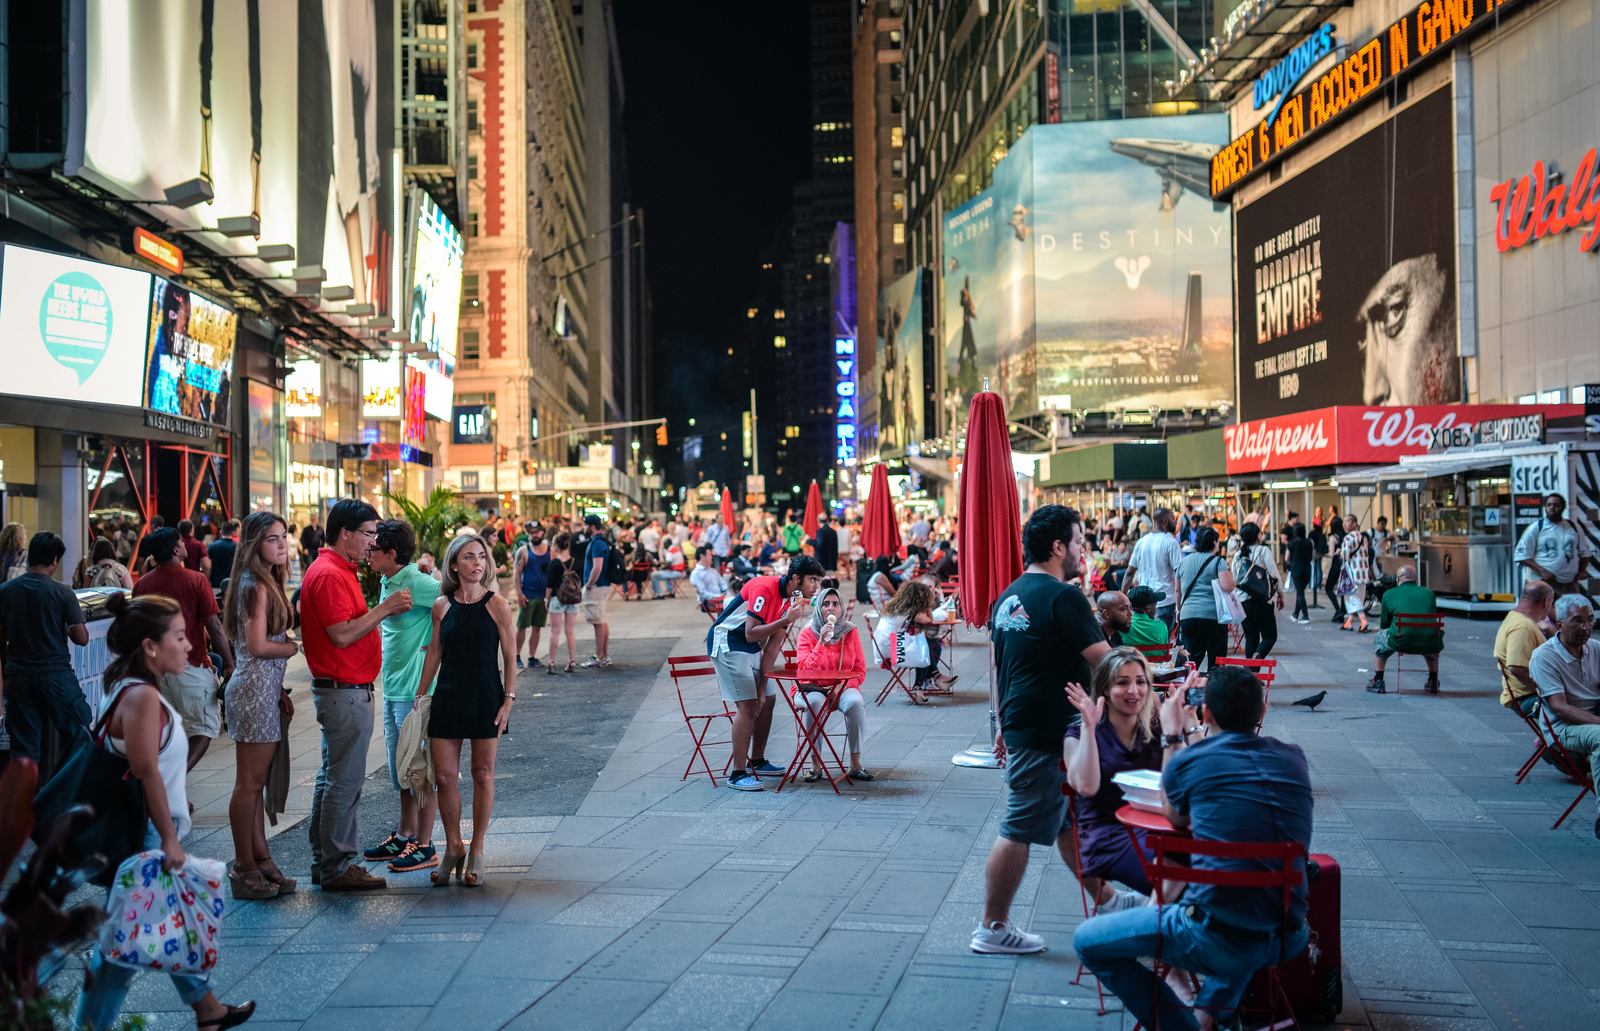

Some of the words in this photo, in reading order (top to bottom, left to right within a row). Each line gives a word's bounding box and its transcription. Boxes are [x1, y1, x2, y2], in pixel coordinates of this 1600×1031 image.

[1212, 130, 1254, 195] ARREST
[1259, 120, 1270, 162] 6
[1275, 94, 1304, 153] MEN
[1310, 38, 1382, 129] ACCUSED
[1389, 18, 1409, 76] IN
[1040, 225, 1224, 252] DESTINY
[1277, 229, 1293, 252] GOES
[1294, 214, 1321, 246] QUIETLY
[1255, 239, 1322, 294] BOARDWALK
[1256, 267, 1323, 345] EMPIRE
[1264, 356, 1277, 376] FINAL
[1296, 345, 1310, 368] SEPT
[1072, 374, 1200, 388] DESTINYTHEGAME.COM
[1280, 372, 1300, 399] HBO
[459, 413, 485, 436] GAP
[1494, 417, 1514, 442] HOT
[1514, 415, 1541, 440] DOGS
[1225, 418, 1329, 470] Walgreens
[753, 595, 765, 613] 8
[897, 632, 906, 664] MoMA
